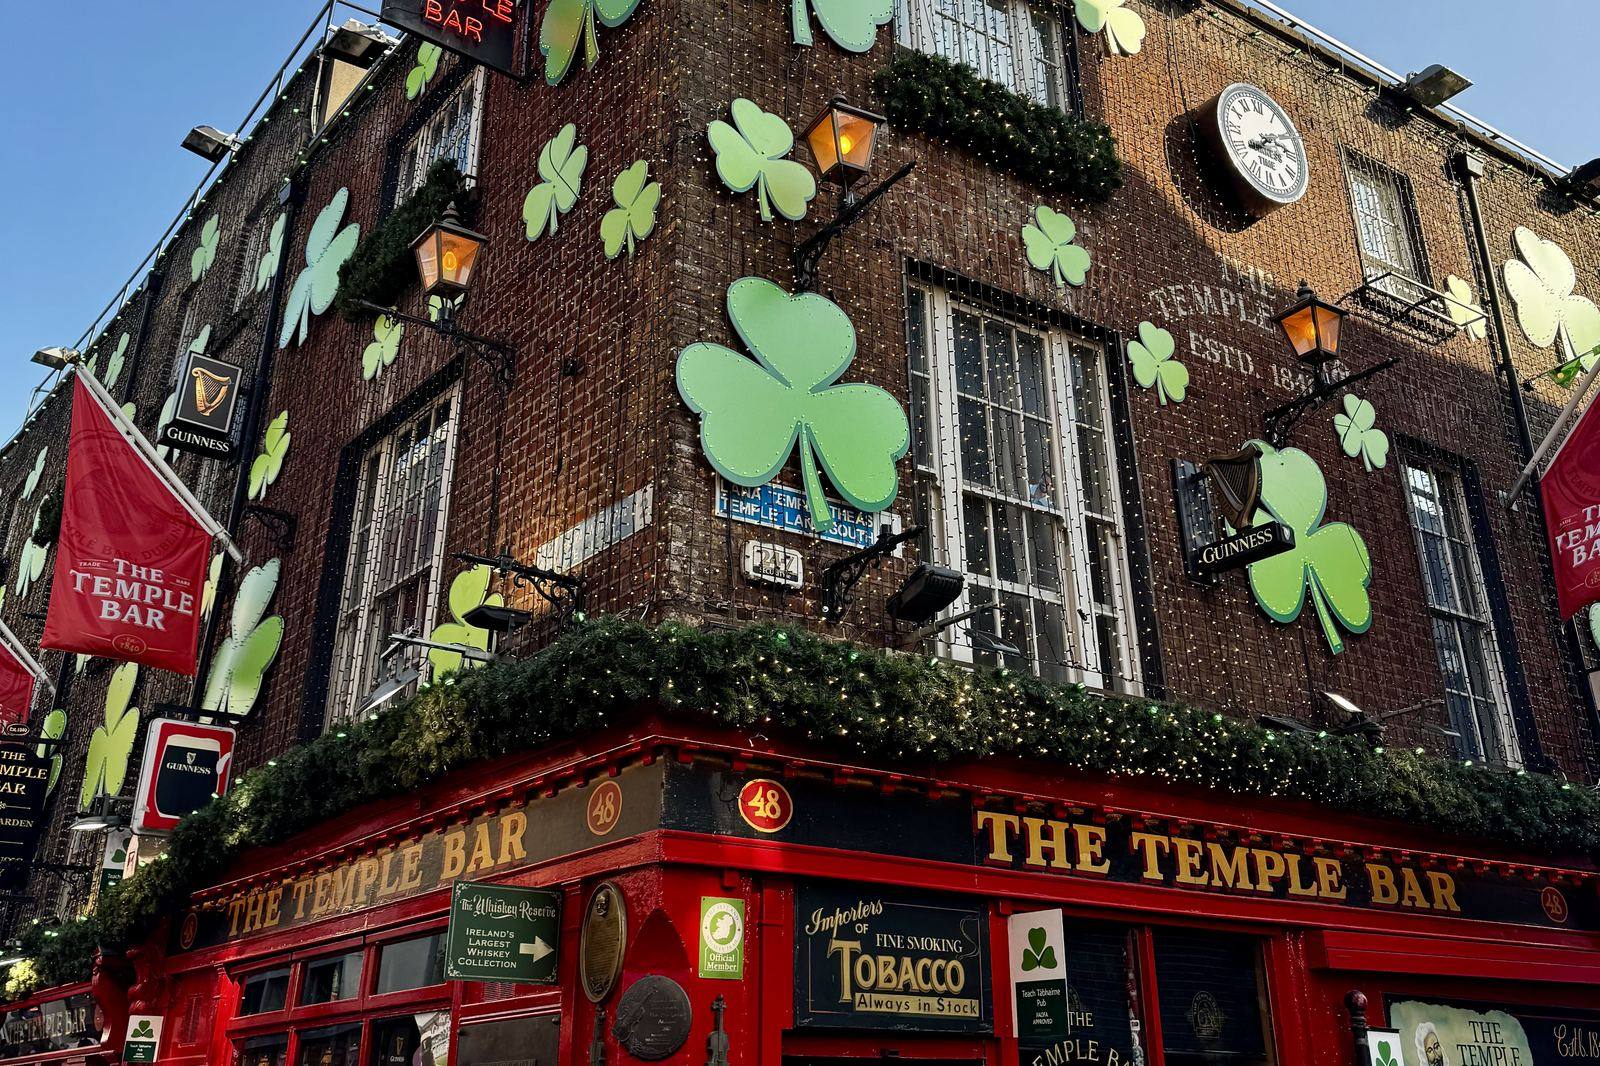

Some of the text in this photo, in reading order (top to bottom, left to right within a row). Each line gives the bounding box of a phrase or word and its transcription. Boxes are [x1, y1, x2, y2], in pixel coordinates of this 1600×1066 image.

[425, 0, 483, 42] BAR
[167, 427, 230, 453] GUINNESS
[721, 496, 875, 546] TEMPLE LAN SOUTH
[1202, 528, 1273, 564] GUINNESS
[113, 558, 164, 583] THE
[69, 569, 195, 615] TEMPLE
[99, 599, 166, 632] BAR
[1, 750, 26, 761] THE
[166, 762, 211, 775] GUINNESS
[747, 786, 782, 819] 48
[977, 811, 1462, 913] THE TEMPLE BAR
[228, 812, 527, 937] THE TEMPLE BAR
[459, 894, 556, 922] The Whiskey Reserve
[805, 899, 884, 941] Importers
[855, 923, 869, 935] OF
[466, 927, 515, 939] IRELAND'S
[468, 937, 511, 948] LARGEST
[876, 933, 963, 953] FINE SMOKING
[457, 956, 517, 968] COLLECTION
[467, 947, 511, 958] WHISKEY
[709, 952, 735, 962] Official
[706, 961, 738, 971] Member
[827, 939, 966, 1004] TOBACCO
[857, 994, 977, 1015] Always in Stock
[1036, 999, 1047, 1007] Pub
[1068, 1011, 1094, 1027] THE
[1468, 1020, 1504, 1044] THE
[1456, 1043, 1523, 1066] TEMPLE
